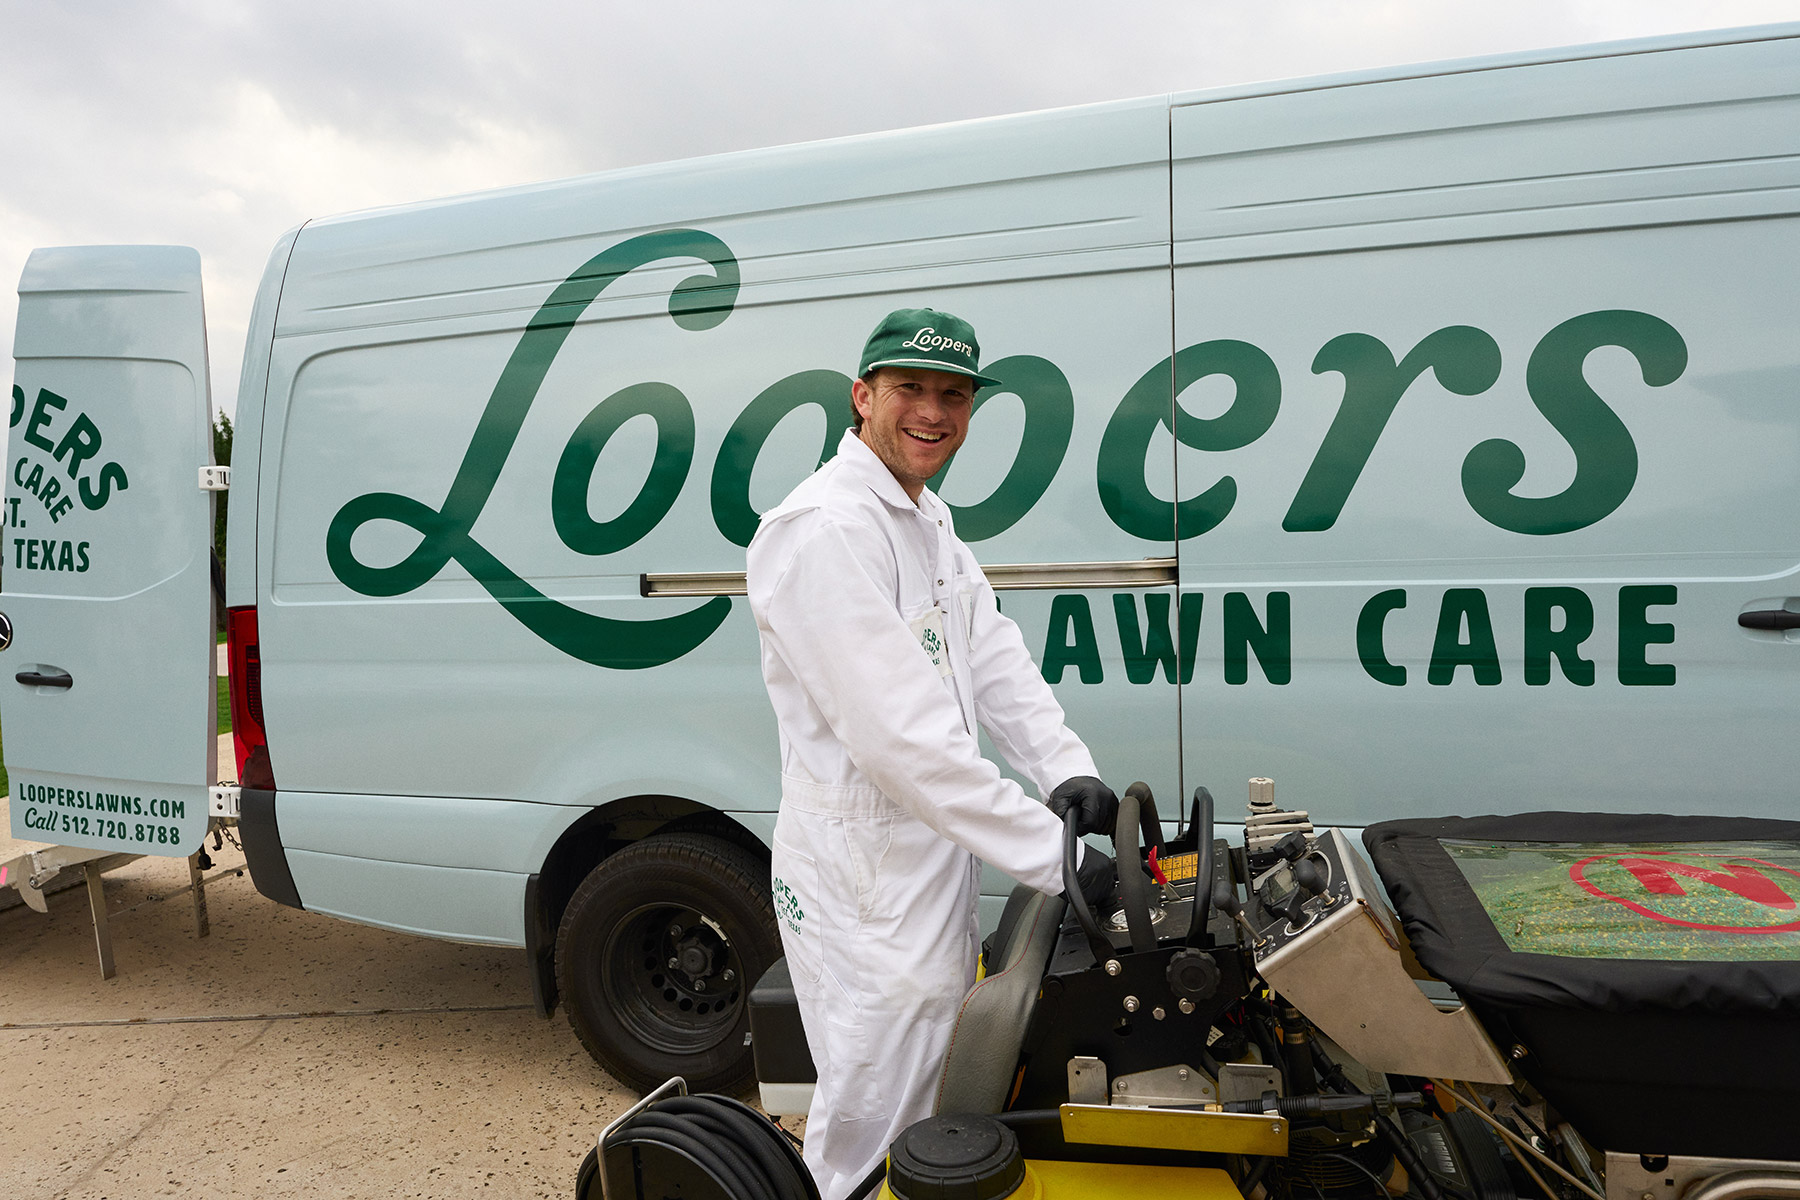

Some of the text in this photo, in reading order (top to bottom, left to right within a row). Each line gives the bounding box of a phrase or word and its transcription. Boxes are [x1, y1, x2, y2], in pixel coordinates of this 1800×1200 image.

[902, 327, 973, 358] Loopers
[14, 457, 74, 524] CARE
[13, 538, 91, 573] TEXAS
[996, 585, 1678, 688] AWN CARE
[19, 782, 186, 819] LOOPERSLAWNS.COM
[24, 807, 180, 846] Call 512.720.8788
